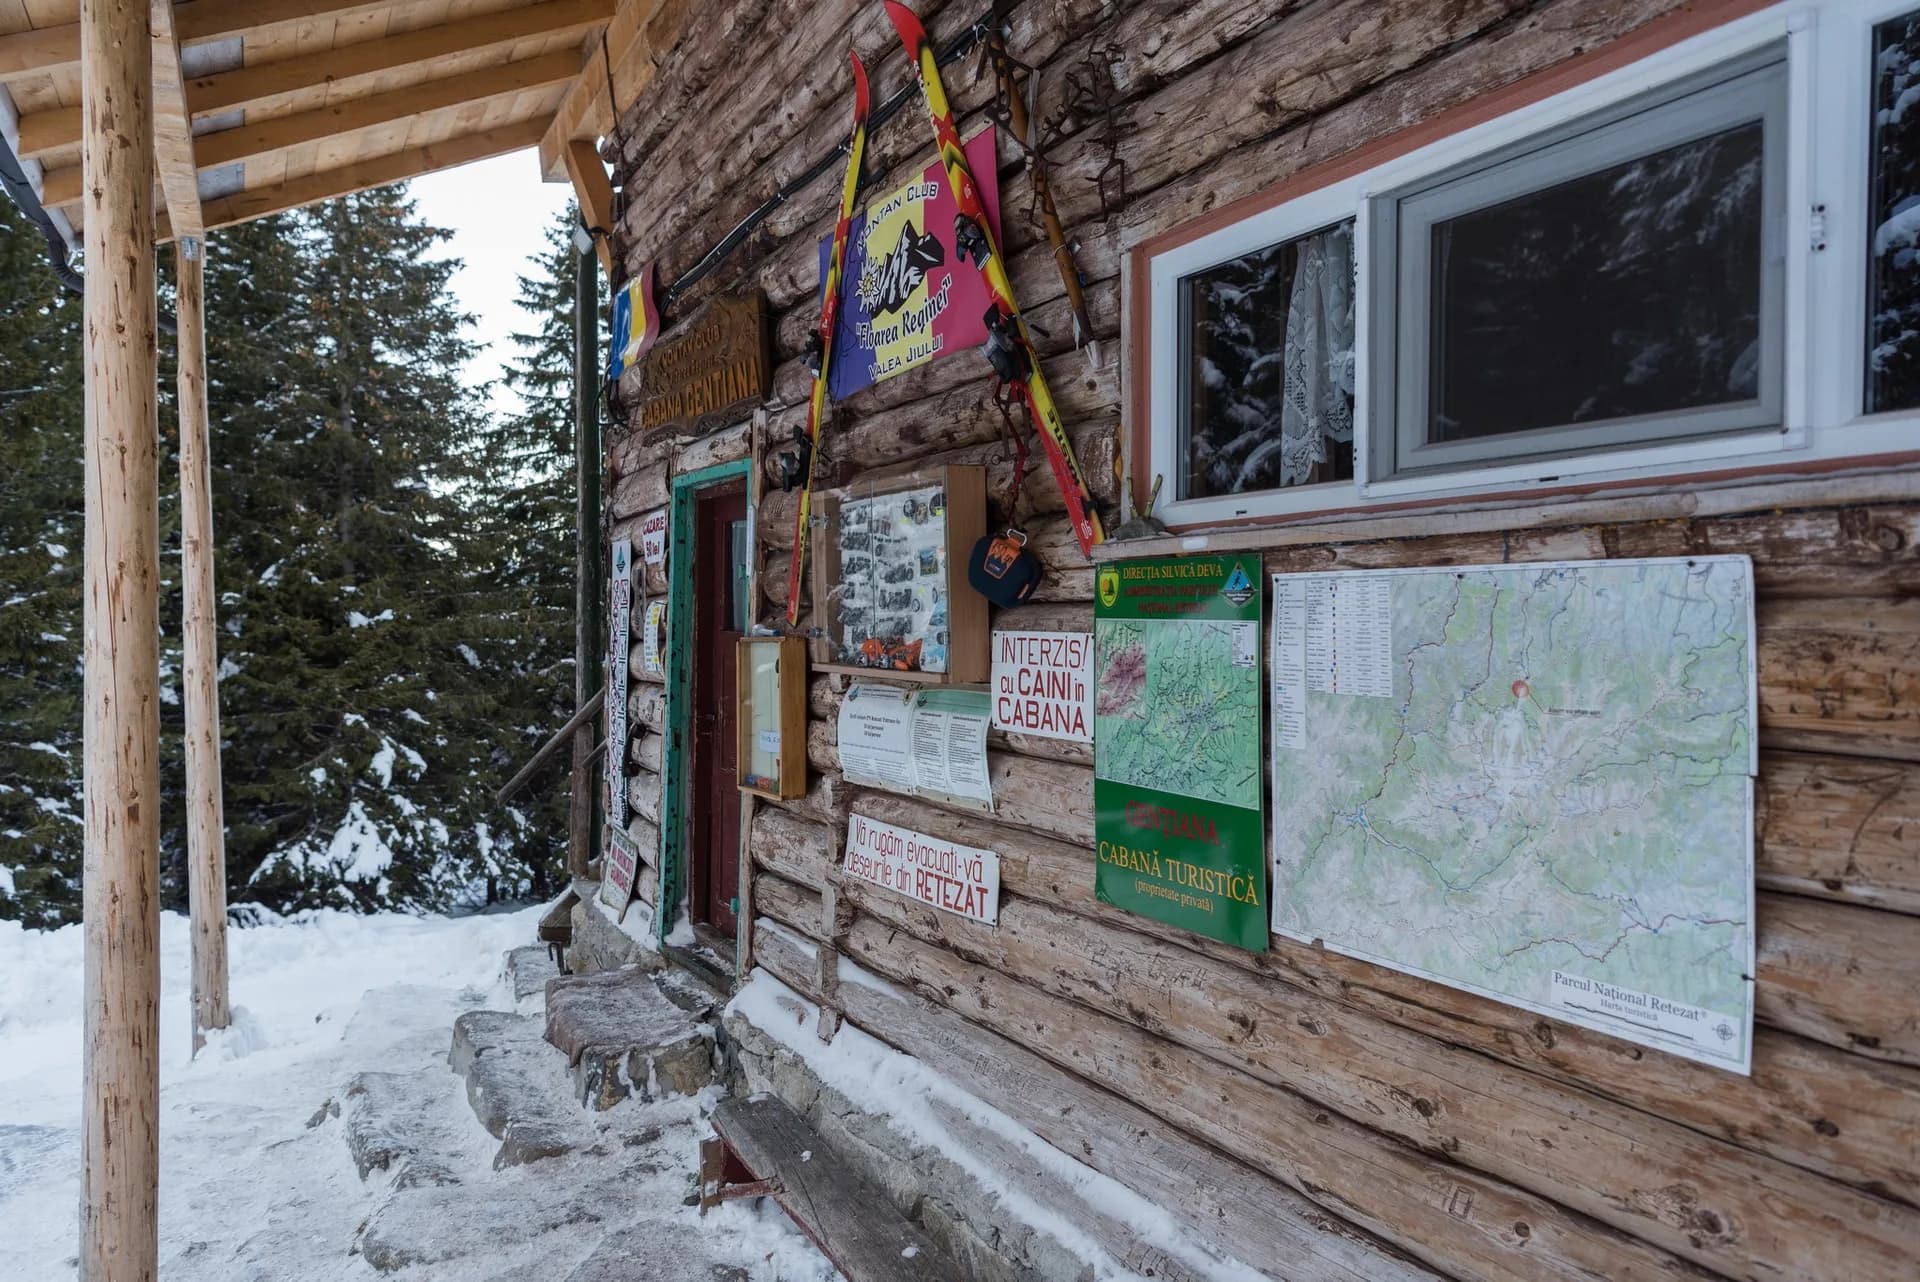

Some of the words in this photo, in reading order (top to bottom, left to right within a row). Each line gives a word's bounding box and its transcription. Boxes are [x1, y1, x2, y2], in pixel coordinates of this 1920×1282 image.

[906, 183, 938, 203] CLUB
[868, 355, 902, 380] VALEA
[906, 334, 943, 363] JIULUI
[685, 355, 760, 418] GENTIANA
[1198, 564, 1223, 577] DEVA
[1000, 675, 1014, 694] cu
[1018, 668, 1071, 701] CAINI
[998, 696, 1087, 737] CABANA
[868, 829, 904, 860] rugăm
[895, 863, 912, 894] din
[915, 867, 989, 918] RETEZAT
[1099, 839, 1163, 879] CABANĂ
[1165, 857, 1260, 906] TURISTICĂ
[1554, 972, 1592, 993] Parcul
[1650, 996, 1701, 1022] Retezat
[1600, 998, 1624, 1013] Harta
